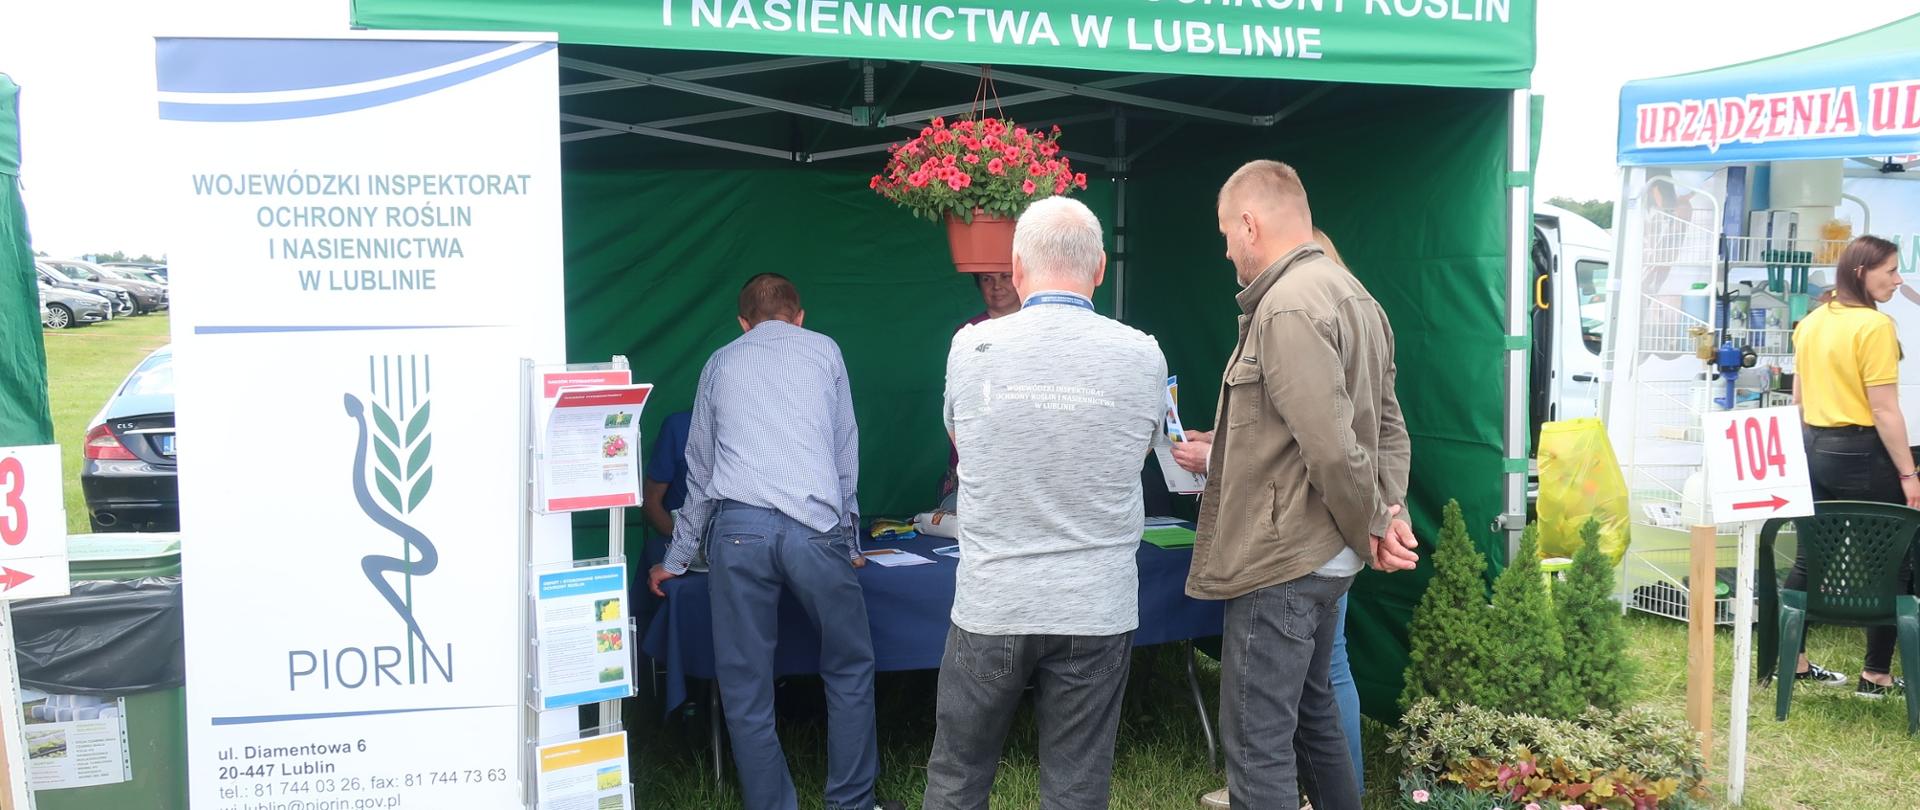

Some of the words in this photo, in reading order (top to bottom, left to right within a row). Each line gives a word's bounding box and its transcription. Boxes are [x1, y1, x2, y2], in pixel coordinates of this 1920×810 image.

[662, 0, 672, 26] I
[692, 0, 1060, 46] NASIENNICTWA
[1070, 13, 1112, 48] W
[1127, 18, 1323, 60] LUBLINIE
[1639, 91, 1856, 147] URZĄDZENIA
[192, 168, 361, 195] WOJEWÓDZKI
[368, 174, 532, 195] INSPEKTORAT
[256, 206, 379, 228] OCHRONY
[386, 201, 472, 227] ROŚLIN
[269, 238, 274, 259] I
[283, 237, 464, 259] NASIENNICTWA
[298, 270, 320, 290] W
[328, 269, 436, 290] LUBLINIE
[1725, 416, 1787, 481] 104
[288, 643, 453, 691] PIORIN
[218, 747, 239, 761] ul.
[244, 741, 352, 760] Diamentowa
[356, 739, 367, 752] 6
[218, 765, 275, 780] 20-447
[281, 762, 336, 776] Lublin
[219, 785, 249, 800] tel.:
[254, 783, 273, 798] 81
[280, 781, 309, 796] 744
[315, 779, 336, 793] 03
[341, 777, 366, 792] 26,
[370, 775, 400, 790] fax:
[404, 774, 423, 787] 81
[429, 772, 458, 786] 744
[464, 770, 483, 784] 73
[488, 768, 507, 782] 63
